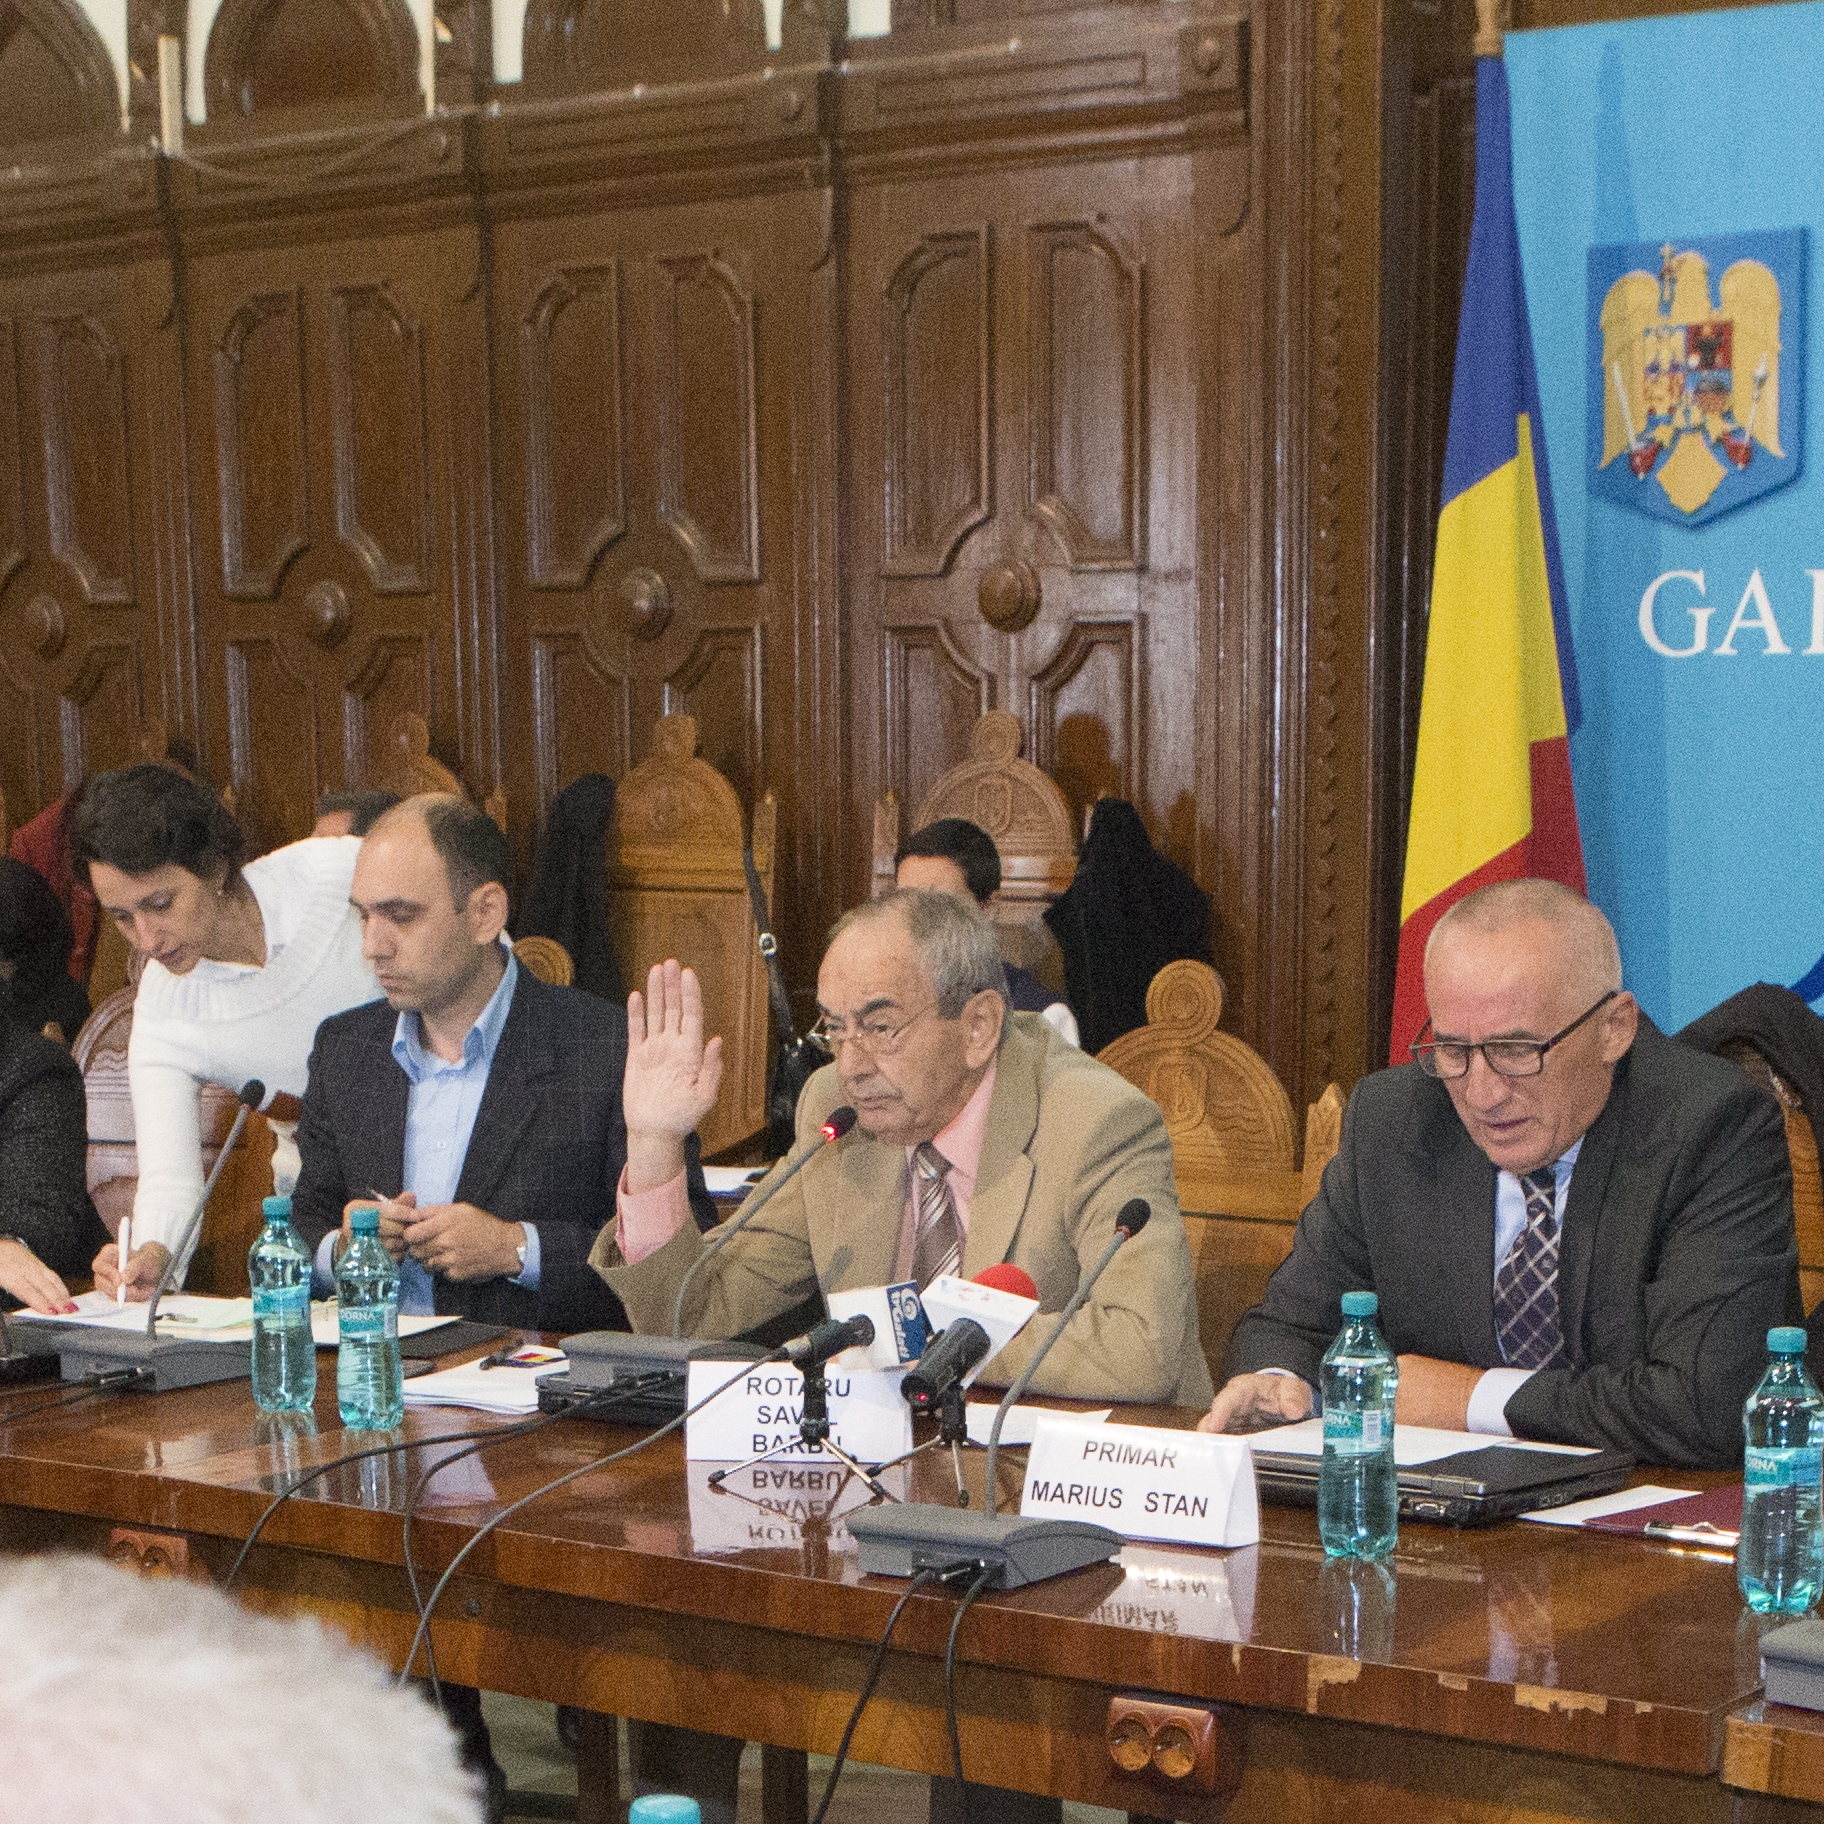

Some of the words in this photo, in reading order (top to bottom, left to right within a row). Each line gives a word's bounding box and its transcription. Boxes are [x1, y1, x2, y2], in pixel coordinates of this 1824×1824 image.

[757, 1405, 838, 1425] SAVL
[1082, 1439, 1178, 1469] PRIMAR
[1031, 1480, 1124, 1510] MARIUS
[1144, 1490, 1209, 1518] STAN
